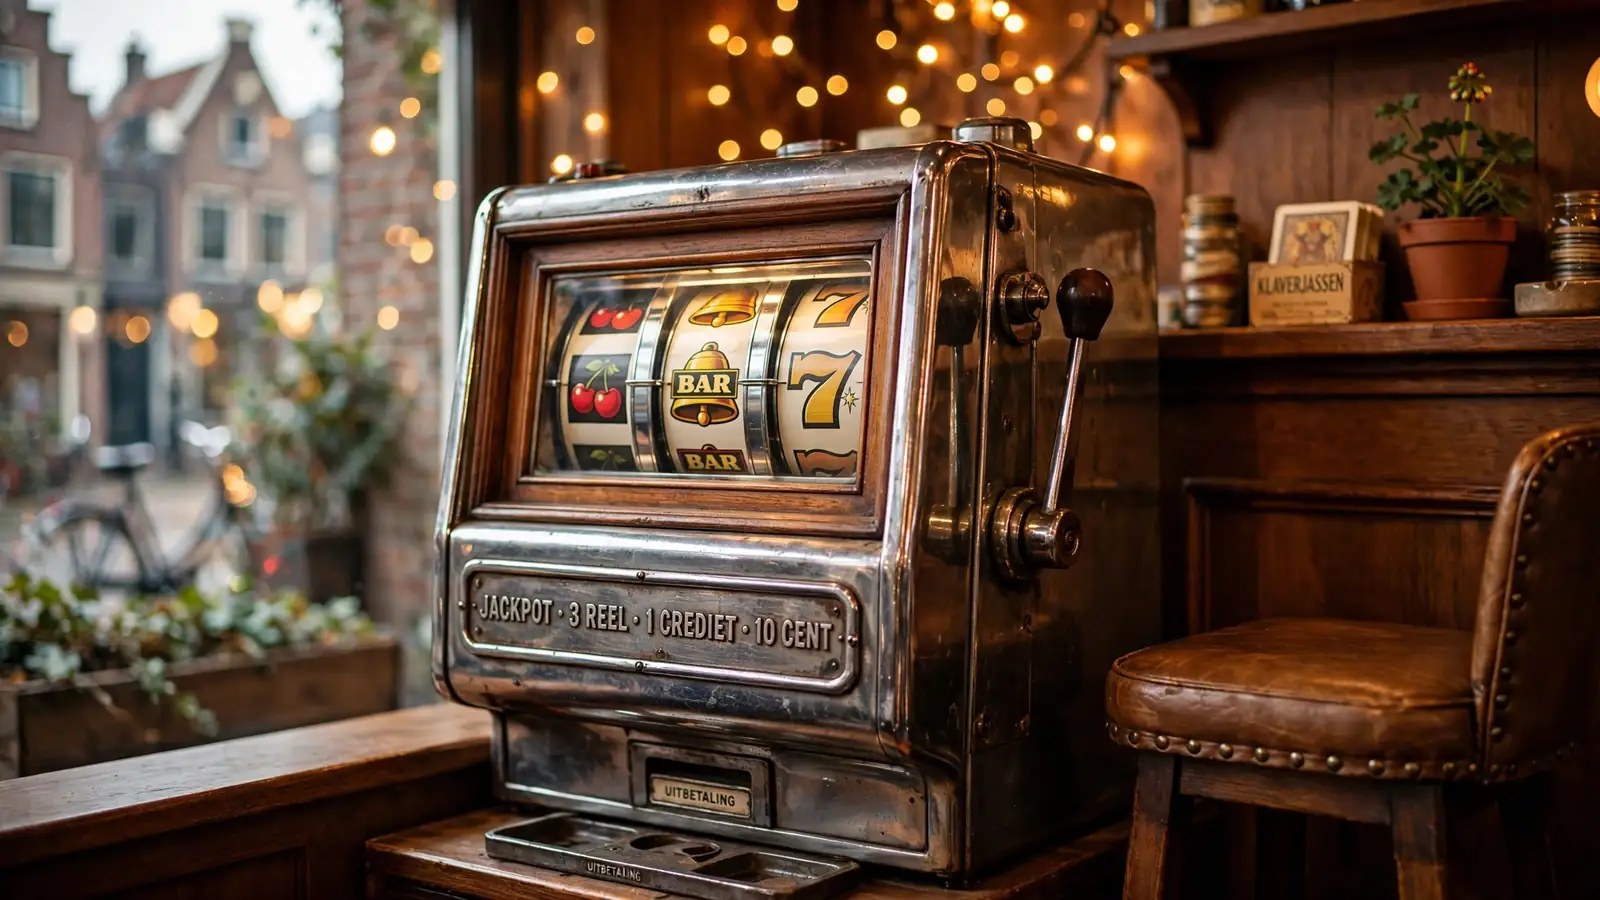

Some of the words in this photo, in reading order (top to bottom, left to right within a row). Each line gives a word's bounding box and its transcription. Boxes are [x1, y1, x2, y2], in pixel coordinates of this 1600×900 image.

[1257, 273, 1344, 295] KLAVERJASSEN
[677, 373, 732, 395] BAR
[787, 350, 862, 429] 7
[685, 453, 741, 471] BAR
[479, 594, 553, 625] JACKPOT
[569, 602, 581, 628] 3
[586, 604, 628, 632] REEL
[645, 608, 654, 634] 1
[659, 609, 738, 641] CREDIET
[754, 617, 776, 645] 10
[781, 619, 834, 650] CENT
[664, 785, 736, 807] UITBETALING
[587, 862, 641, 882] UITBETALING
